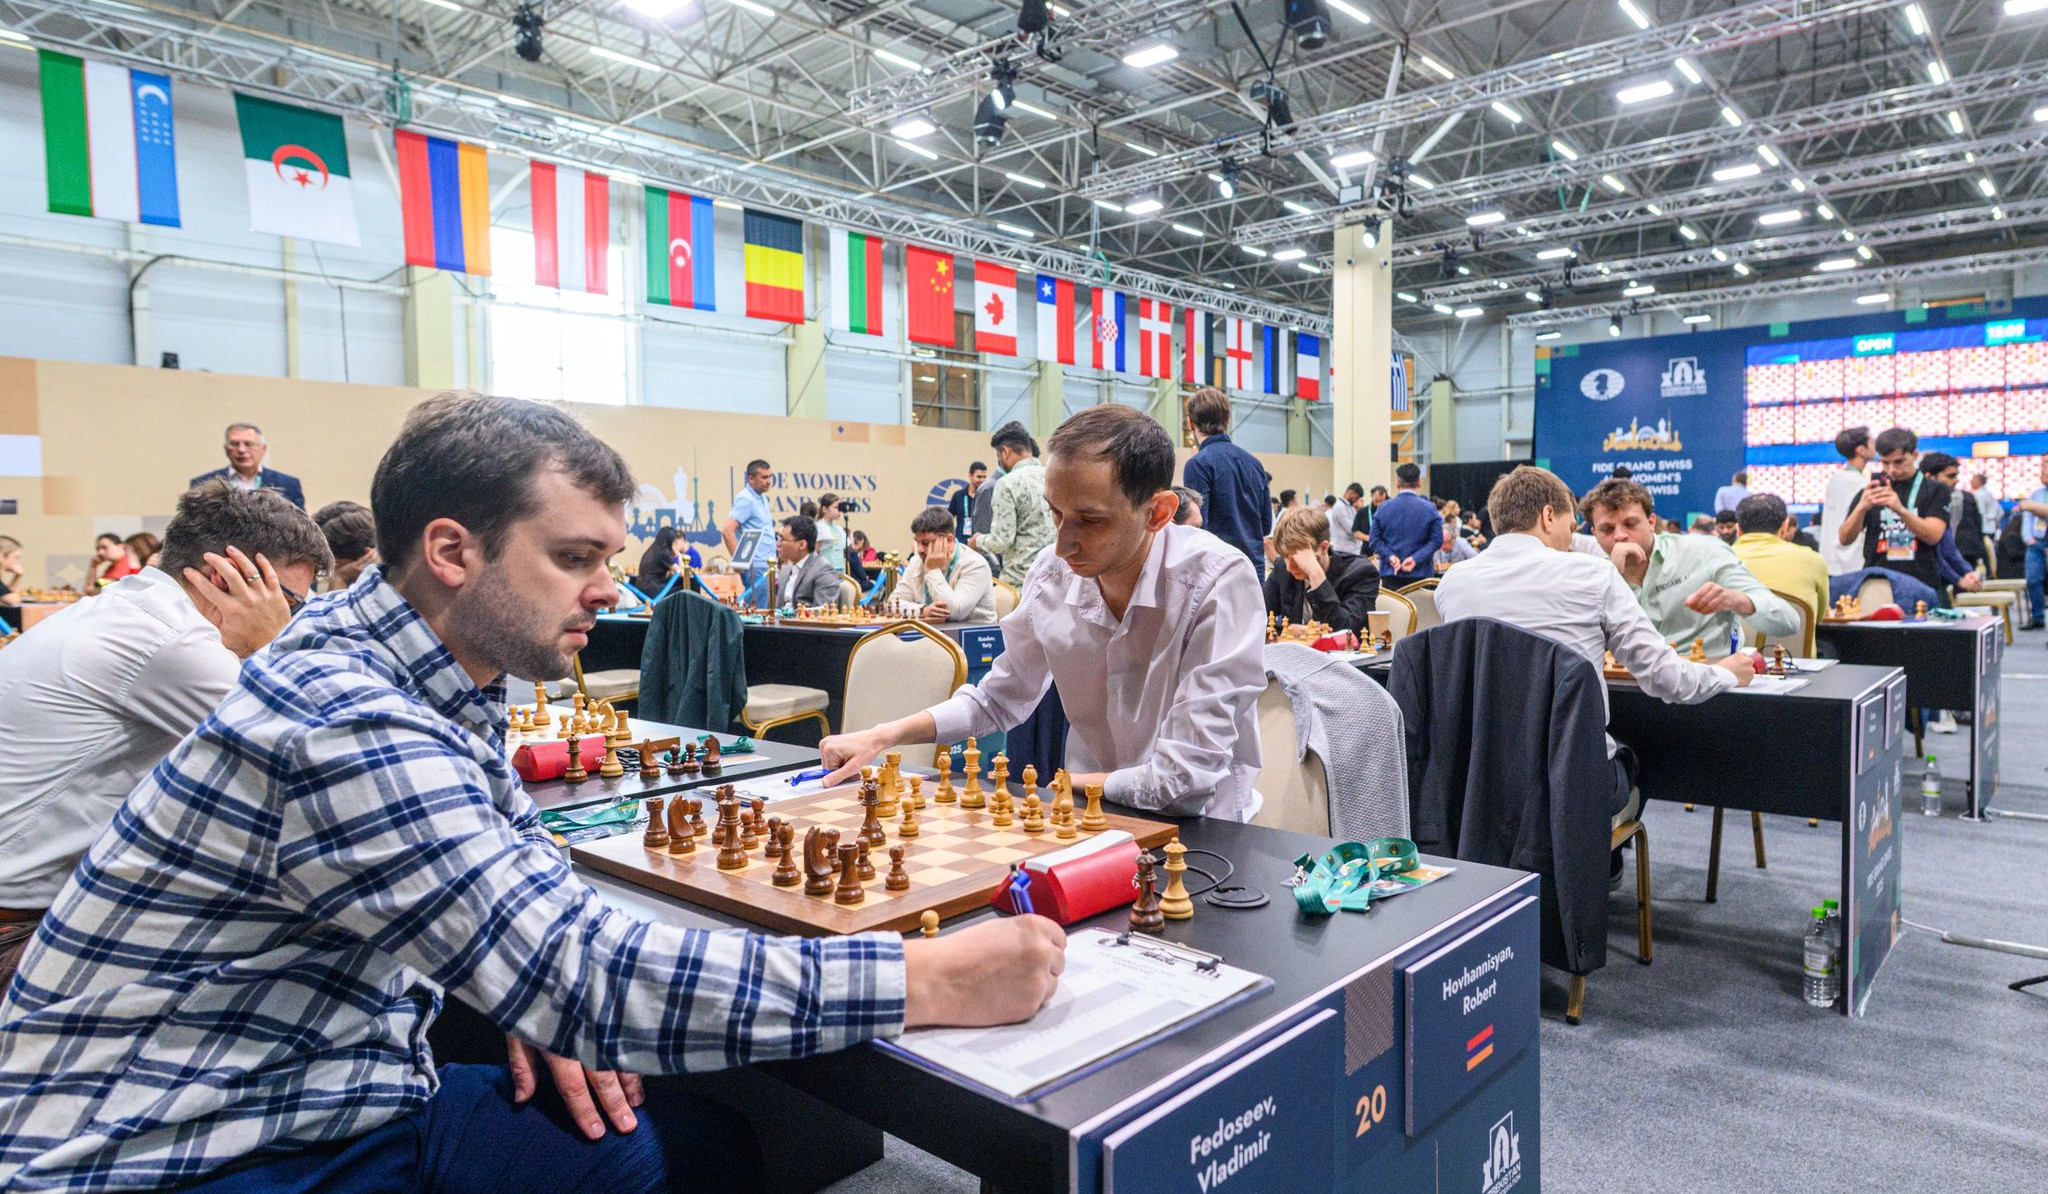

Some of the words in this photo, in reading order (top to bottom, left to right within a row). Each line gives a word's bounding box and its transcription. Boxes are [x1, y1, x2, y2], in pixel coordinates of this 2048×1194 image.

[1856, 337, 1893, 352] OPEN
[1592, 462, 1615, 473] FIDE
[1658, 459, 1693, 470] SWISS
[1443, 946, 1514, 1001] Hovhannisyan,
[1463, 979, 1497, 1016] Robert
[1190, 1095, 1277, 1165] Fedoseev,
[1355, 1084, 1387, 1139] 20
[1197, 1130, 1271, 1194] Vladimir
